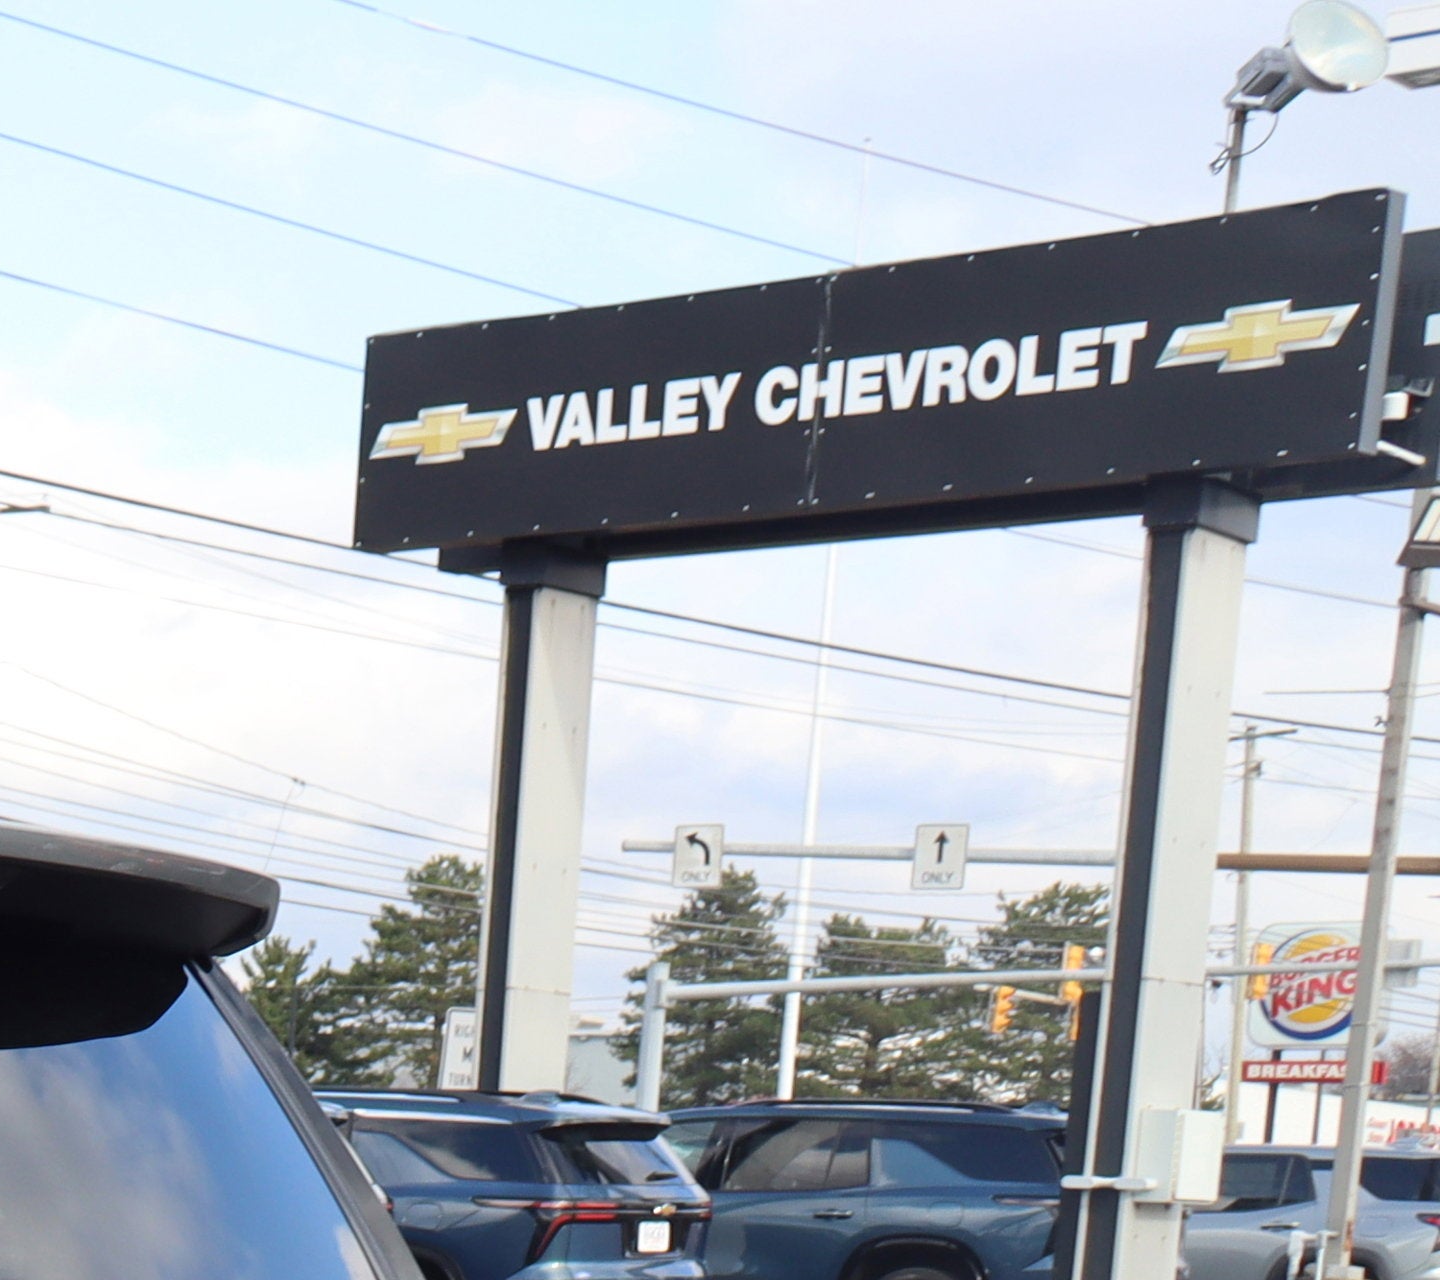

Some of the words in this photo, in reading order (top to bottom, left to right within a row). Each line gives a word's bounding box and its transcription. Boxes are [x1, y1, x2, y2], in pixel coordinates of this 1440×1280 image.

[527, 371, 741, 452] VALLEY
[755, 320, 1149, 424] CHEVROLET
[681, 869, 712, 883] ONLY
[921, 870, 954, 884] ONLY
[1270, 968, 1358, 1018] KING
